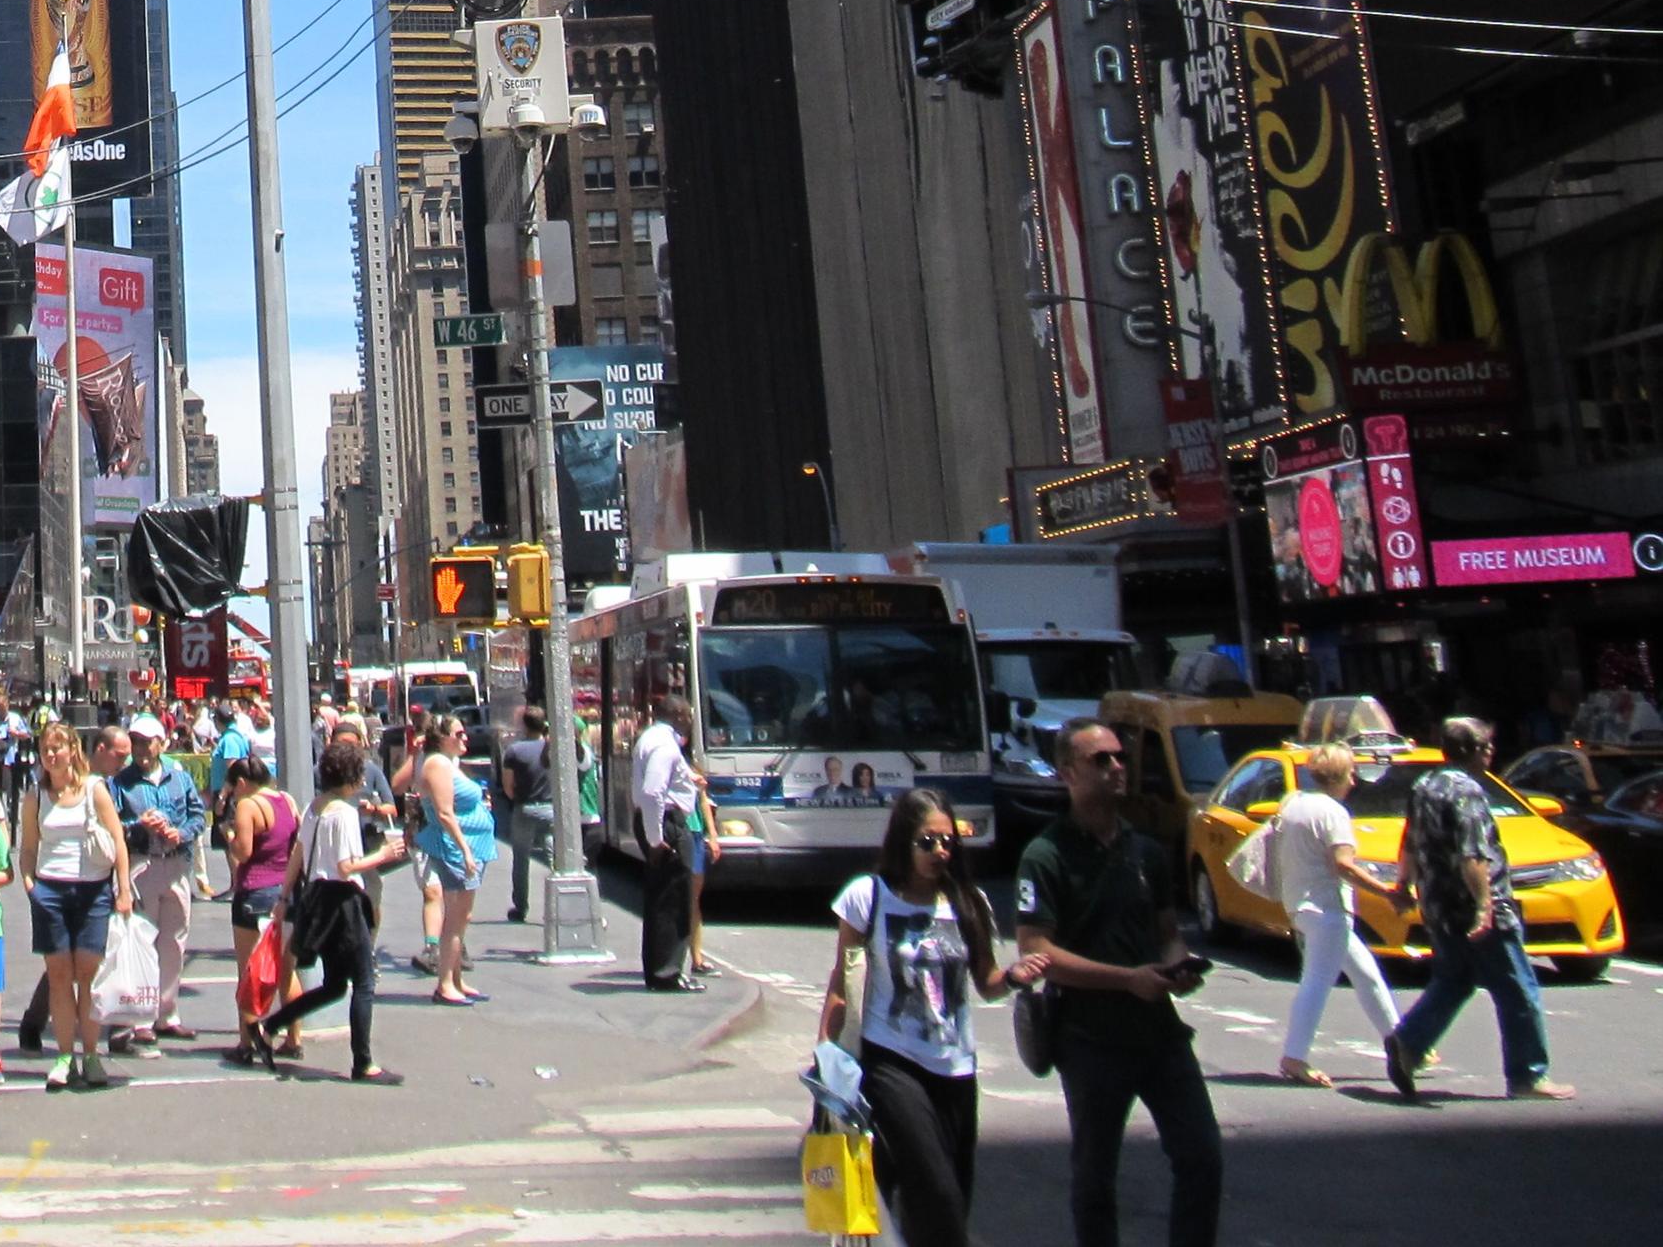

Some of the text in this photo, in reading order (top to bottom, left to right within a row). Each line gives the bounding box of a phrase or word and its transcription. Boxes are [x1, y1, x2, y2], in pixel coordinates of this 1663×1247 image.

[504, 78, 542, 90] SECURITY
[1183, 44, 1230, 107] HEAR
[1204, 86, 1238, 143] ME
[35, 261, 63, 278] thday
[102, 275, 139, 304] Gift
[43, 310, 60, 324] For
[438, 317, 498, 342] W 46 ST
[606, 364, 631, 382] NO
[1352, 360, 1512, 386] McDonald's
[489, 393, 569, 415] ONE AY
[605, 385, 654, 406] O COU
[1379, 384, 1485, 402] Restaurant
[580, 509, 623, 532] THE
[1459, 547, 1607, 570] FREE MUSEUM
[734, 777, 762, 788] 3932
